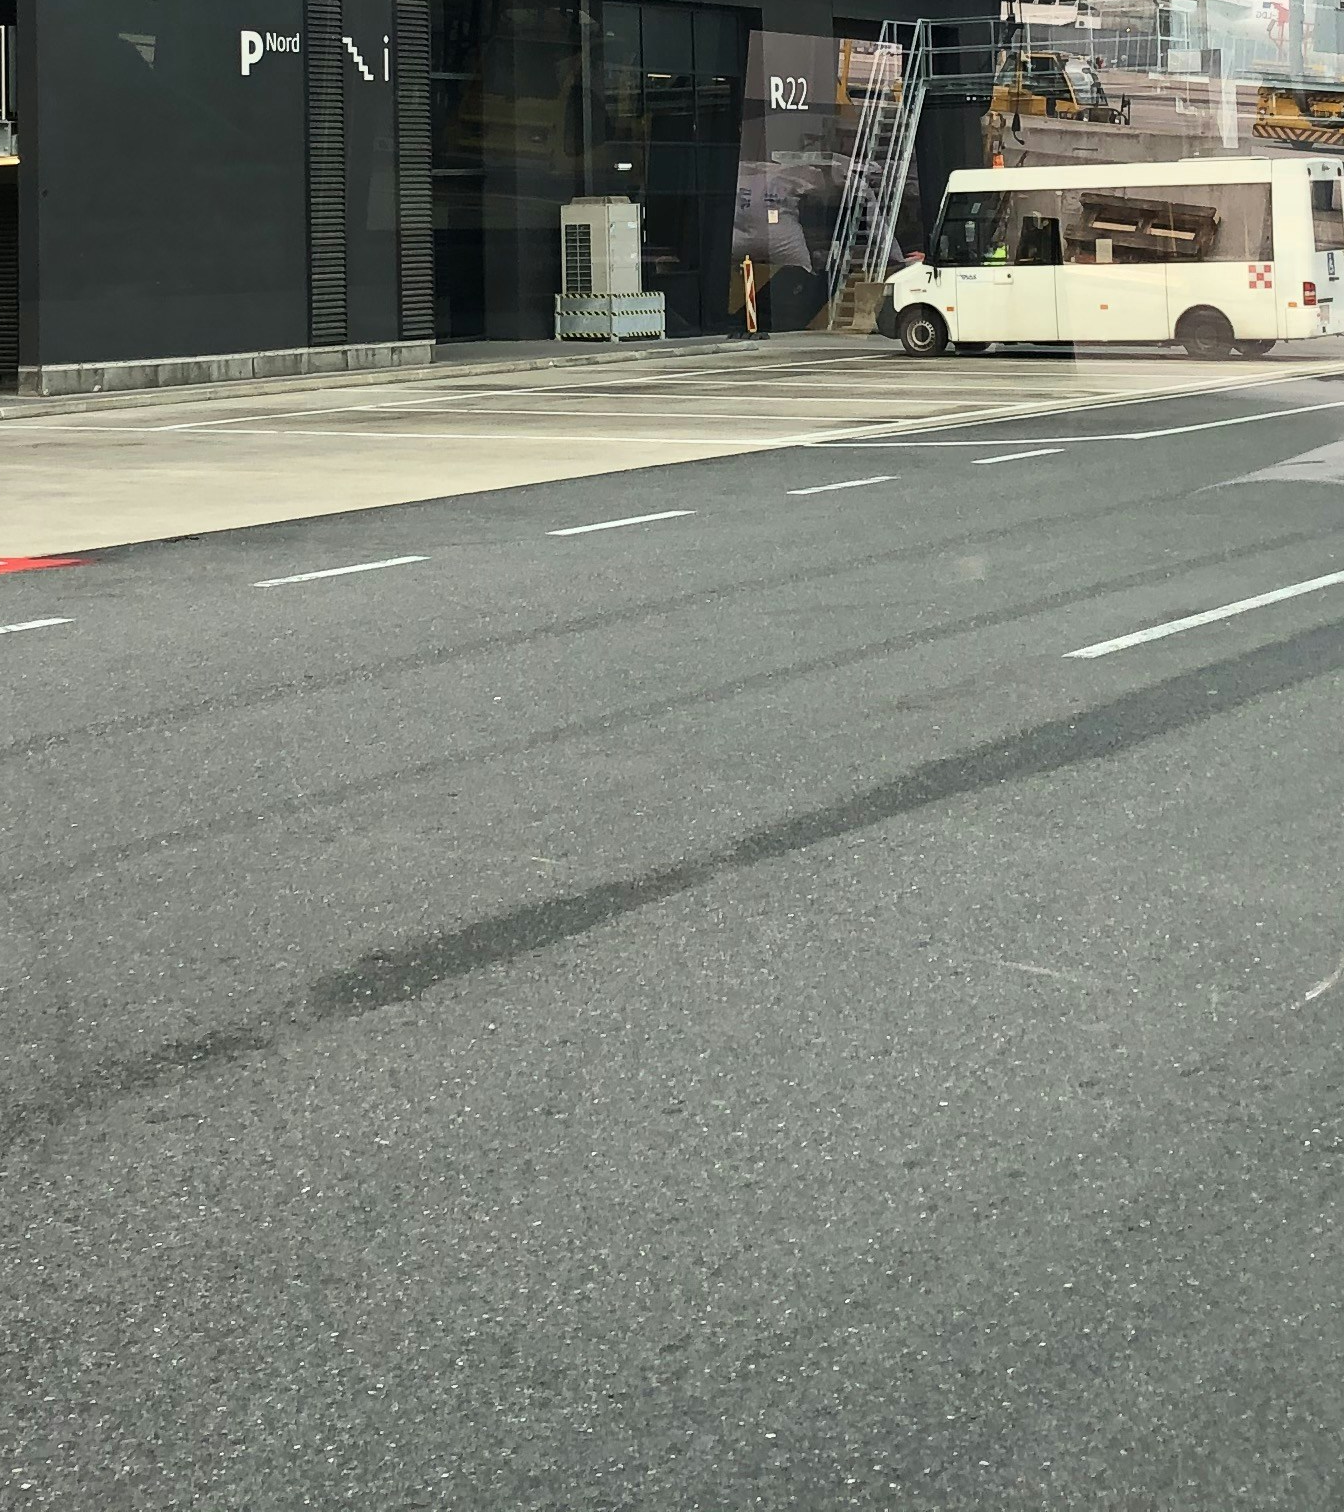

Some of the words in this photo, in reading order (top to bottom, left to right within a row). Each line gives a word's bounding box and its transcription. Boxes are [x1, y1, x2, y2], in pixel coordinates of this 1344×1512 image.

[240, 30, 264, 76] P
[265, 32, 300, 53] Nord
[769, 76, 809, 110] R22
[925, 271, 933, 284] 7
